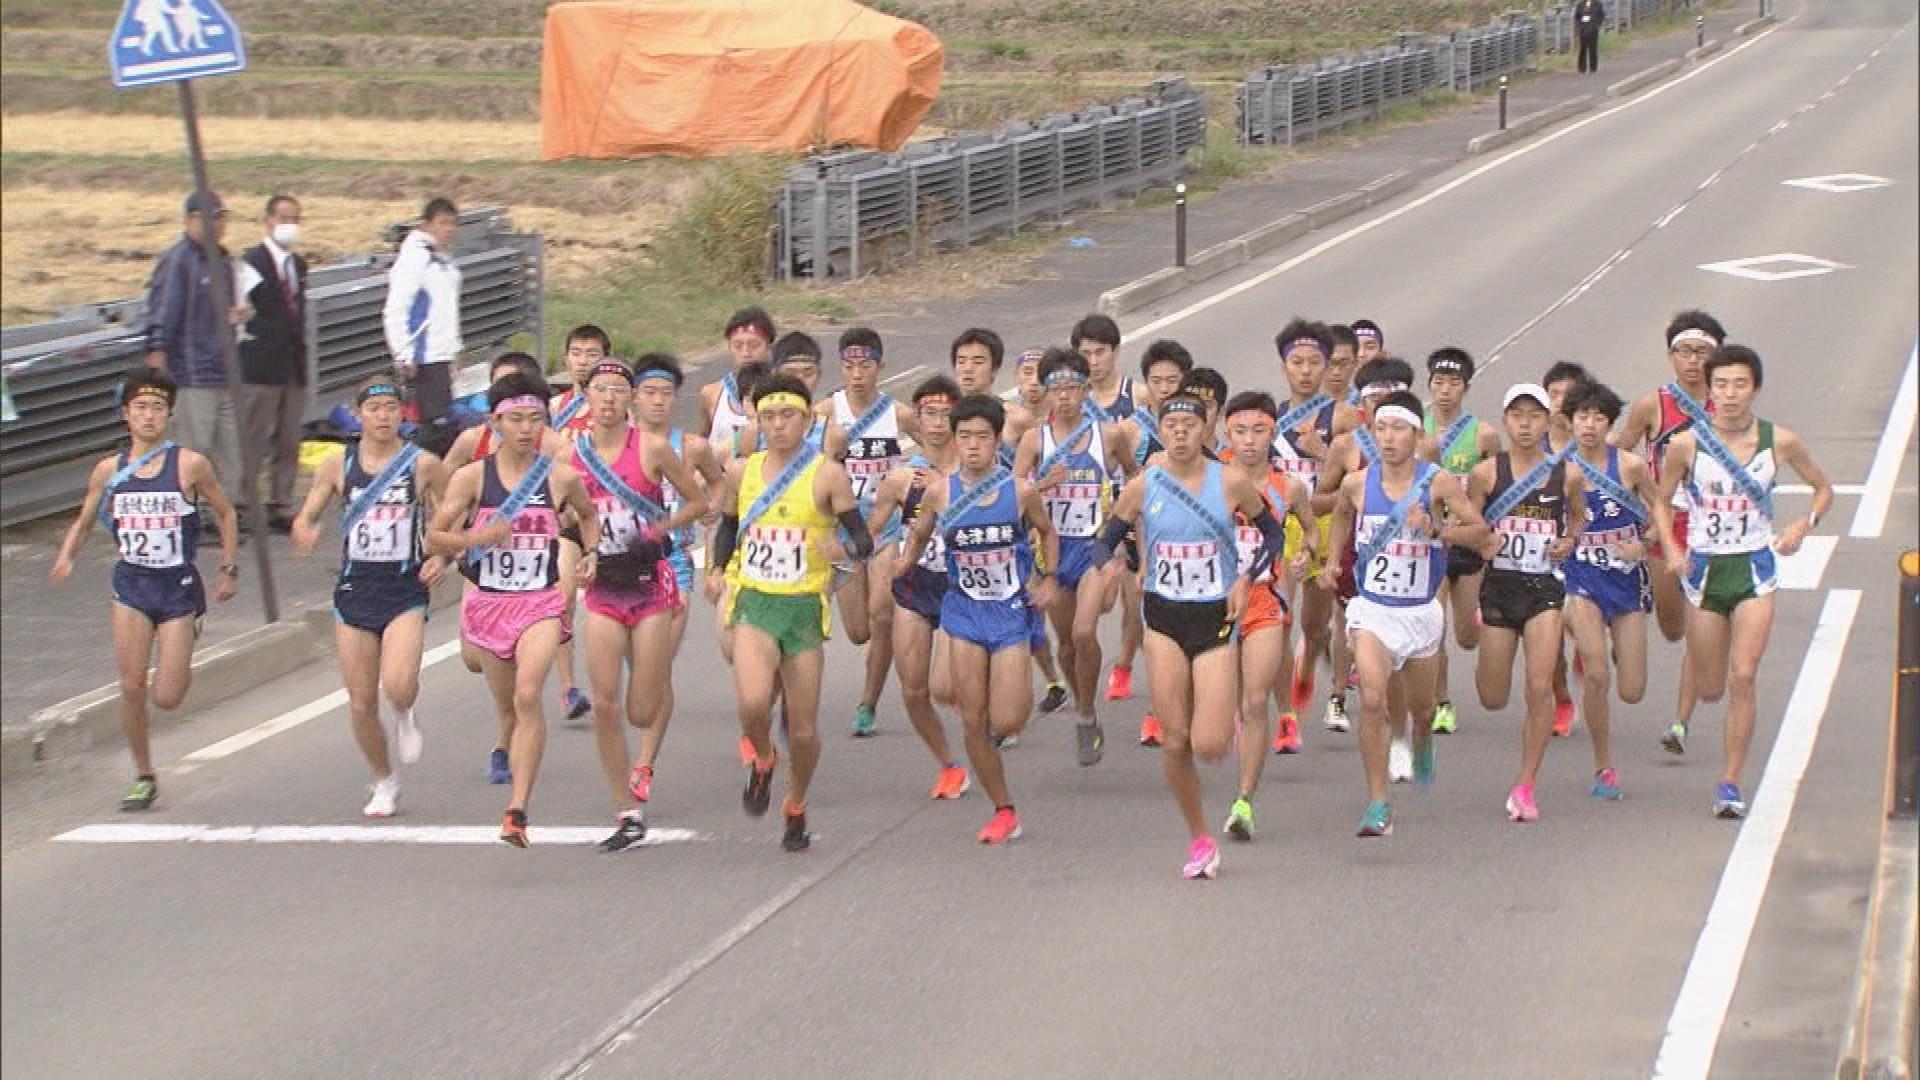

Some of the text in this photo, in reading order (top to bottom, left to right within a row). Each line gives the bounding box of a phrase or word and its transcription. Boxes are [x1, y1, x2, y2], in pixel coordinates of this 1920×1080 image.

[1046, 500, 1097, 525] 17-1
[1706, 512, 1749, 537] 3-1
[121, 531, 177, 557] 12-1
[357, 522, 398, 549] 6-1
[485, 551, 544, 579] 19-1
[747, 540, 802, 571] 22-1
[961, 563, 1013, 589] 33-1
[1158, 558, 1215, 587] 21-1
[1373, 555, 1417, 587] 2-1
